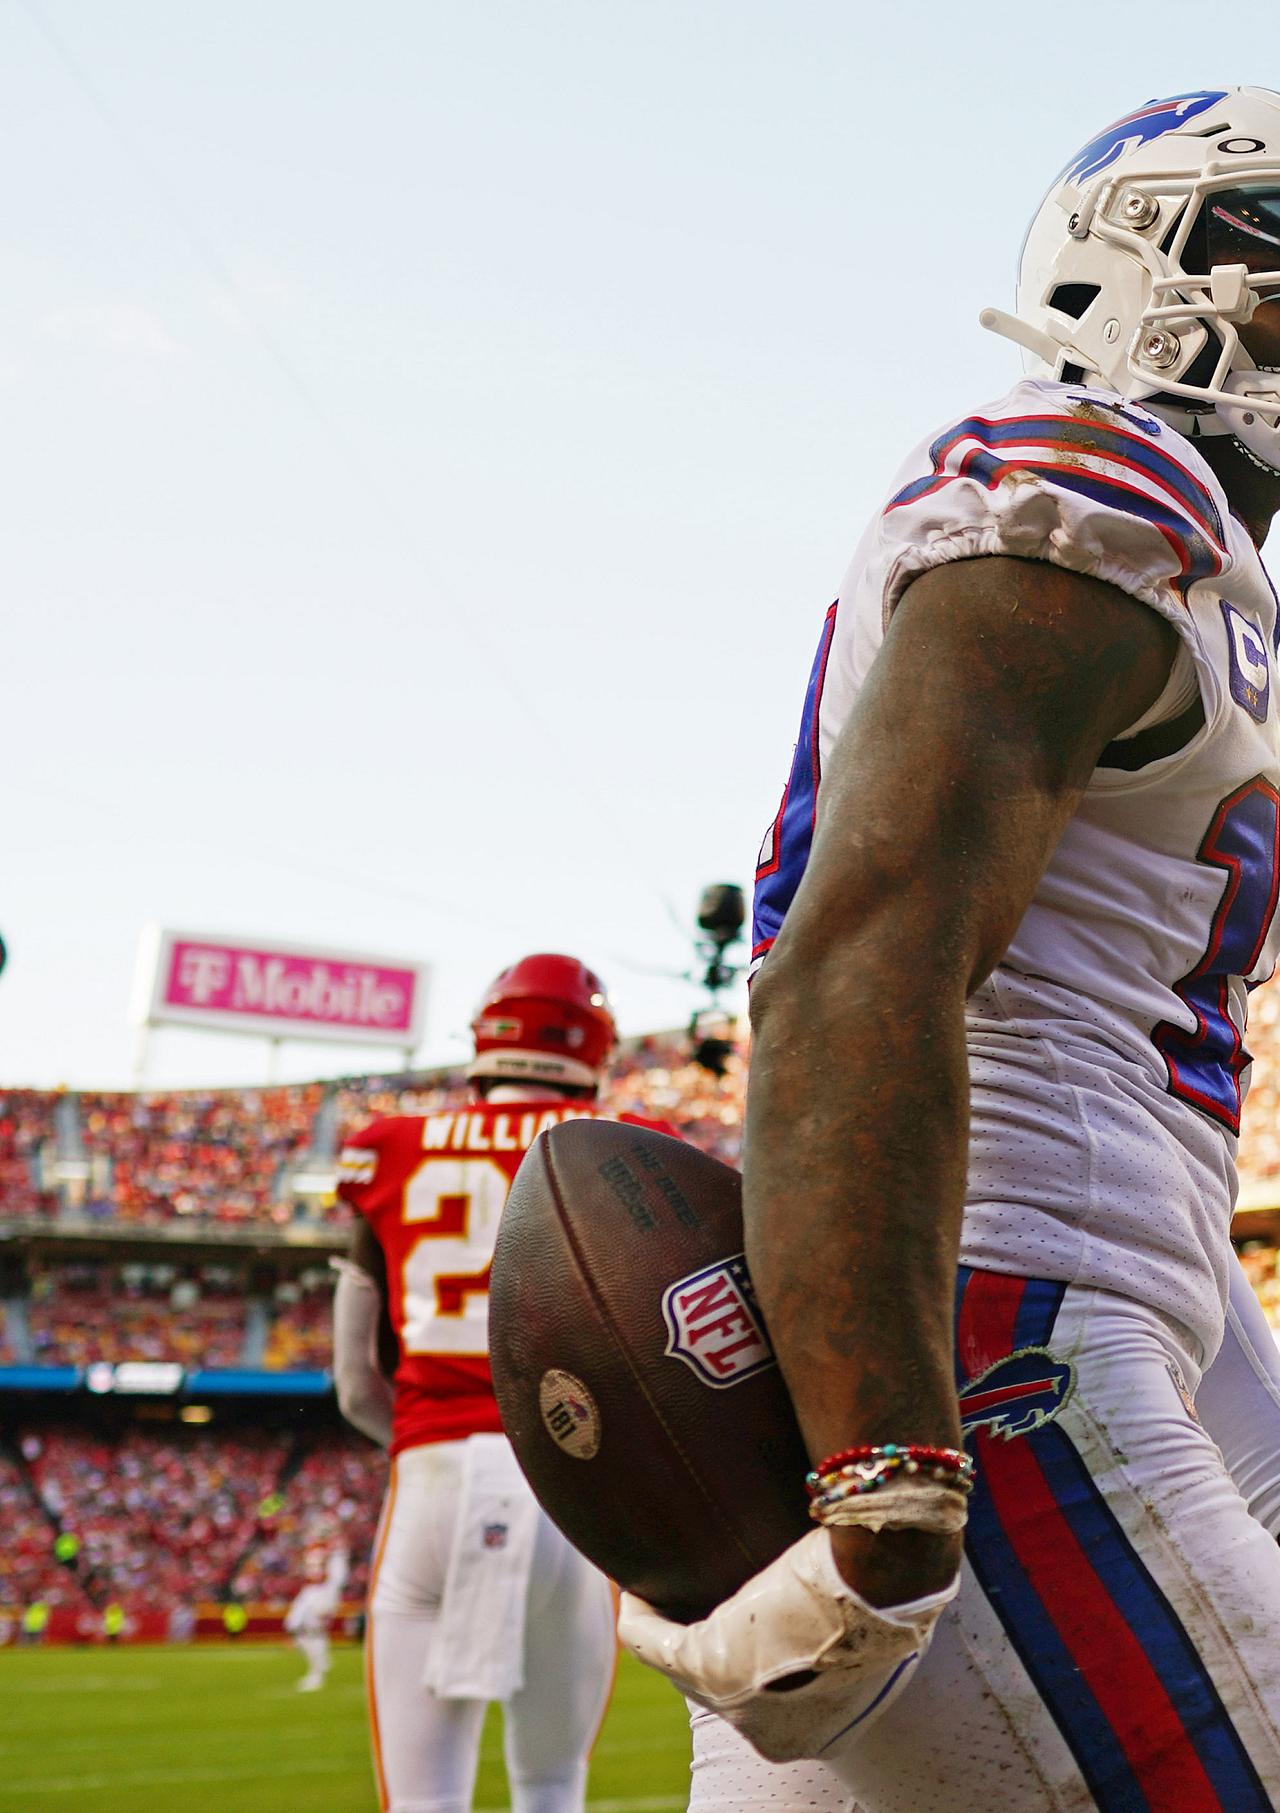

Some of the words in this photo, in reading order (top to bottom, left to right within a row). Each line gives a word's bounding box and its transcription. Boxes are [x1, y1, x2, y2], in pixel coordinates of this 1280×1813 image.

[1230, 609, 1269, 692] C
[234, 953, 403, 1024] Mobile
[679, 1274, 763, 1377] NFL
[545, 1400, 578, 1442] 181
